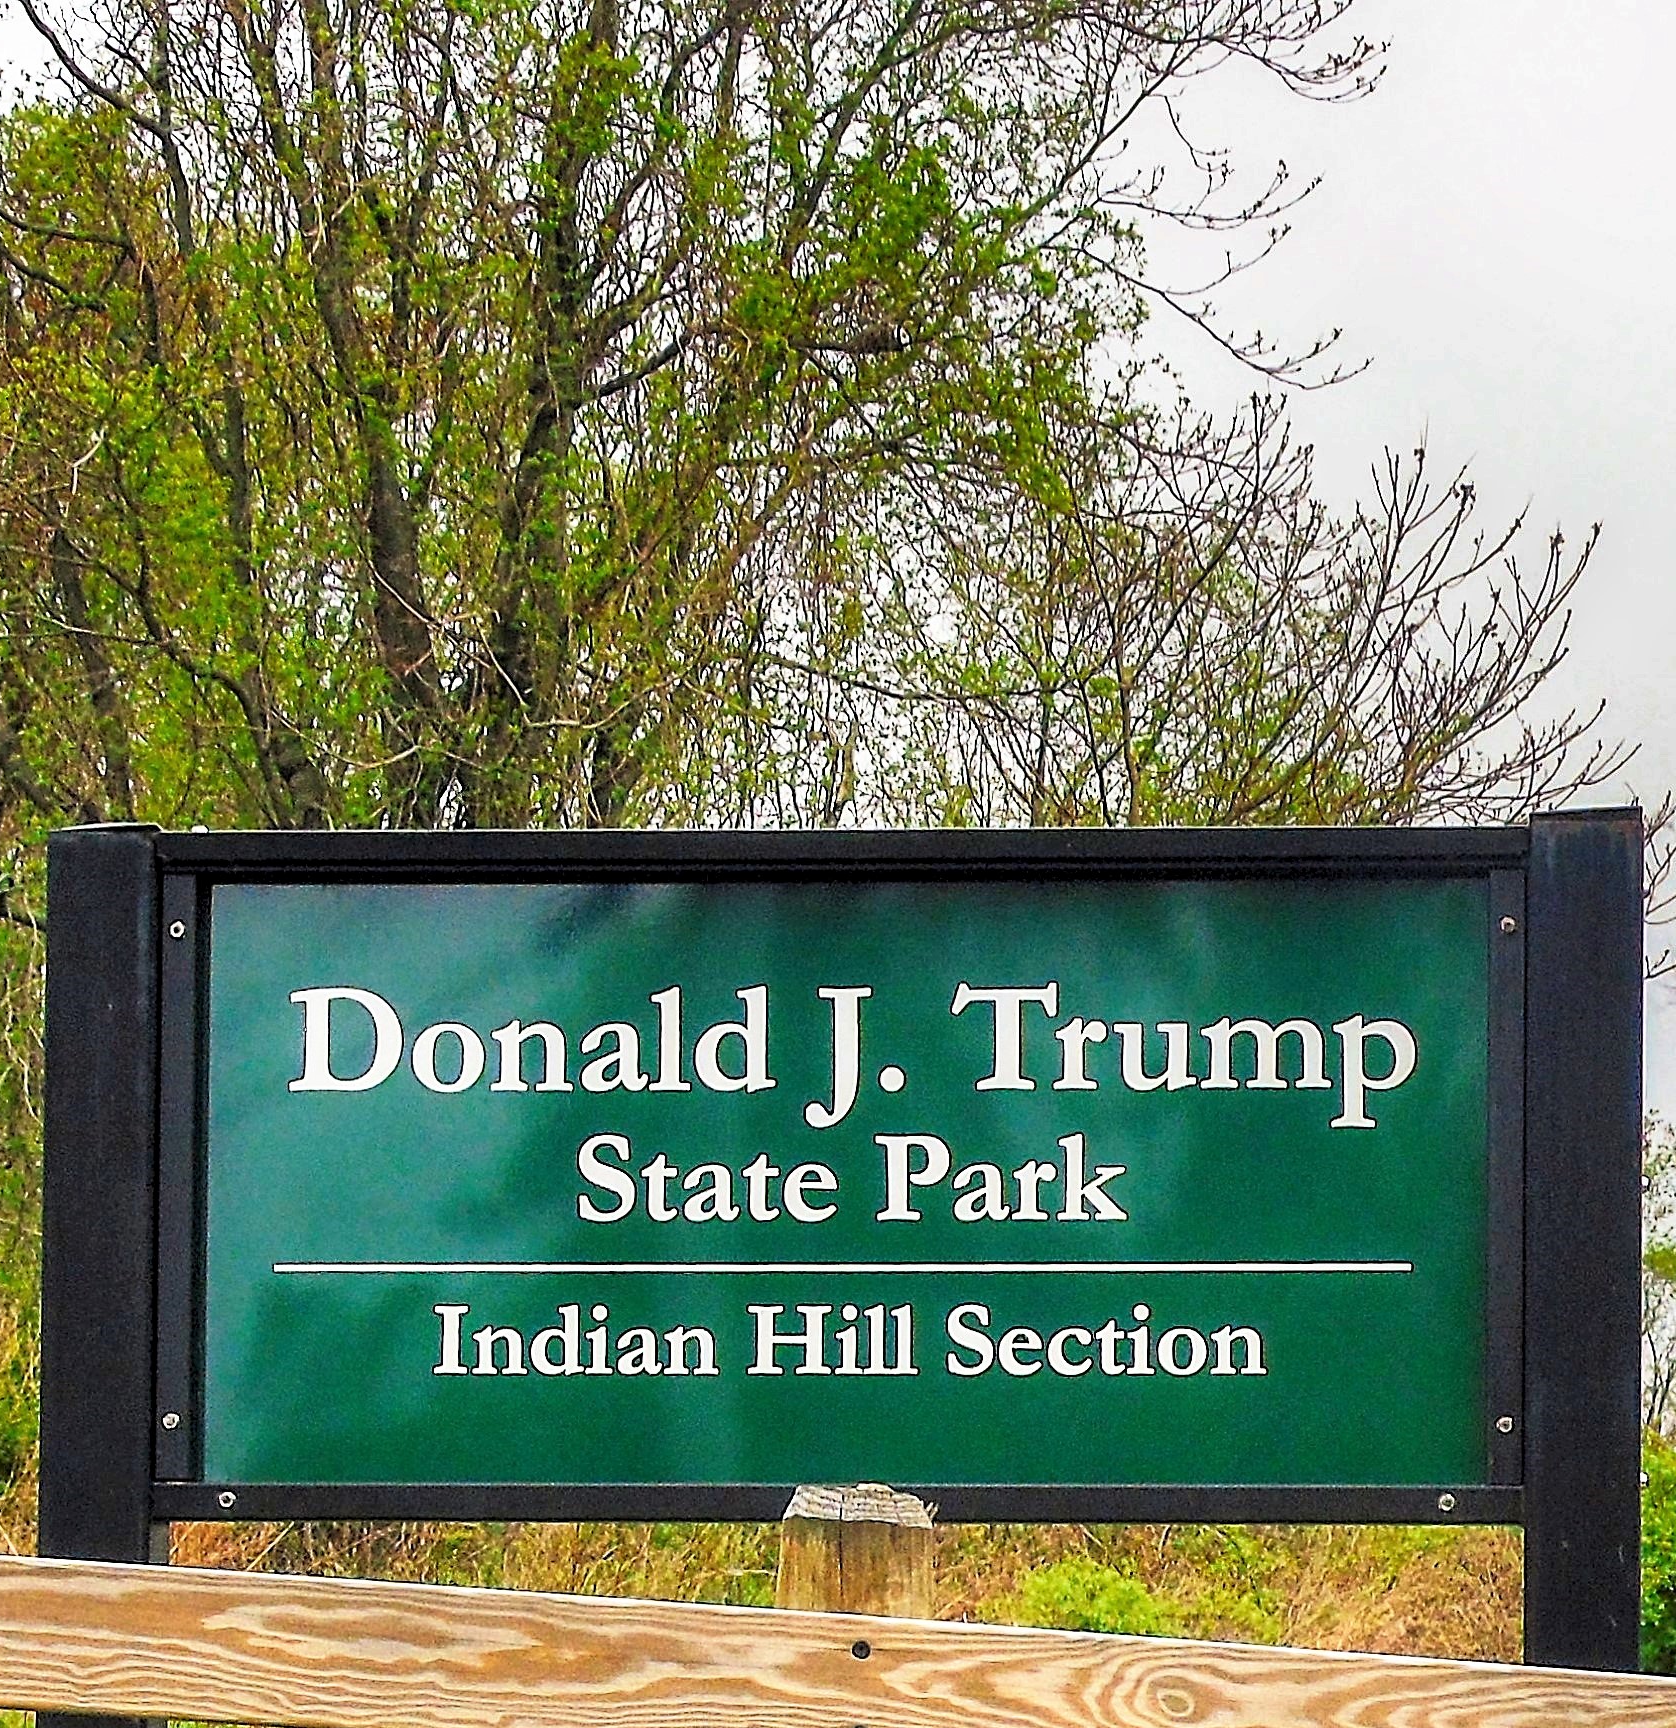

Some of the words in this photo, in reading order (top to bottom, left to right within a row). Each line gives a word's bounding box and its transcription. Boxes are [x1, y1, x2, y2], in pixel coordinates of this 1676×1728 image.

[287, 984, 777, 1094] Donald
[804, 986, 906, 1129] J.
[950, 981, 1417, 1129] Trump
[577, 1133, 839, 1223] State
[874, 1132, 1128, 1222] Park
[432, 1303, 721, 1377] Indian
[746, 1303, 920, 1376] Hill
[946, 1303, 1268, 1377] Section
